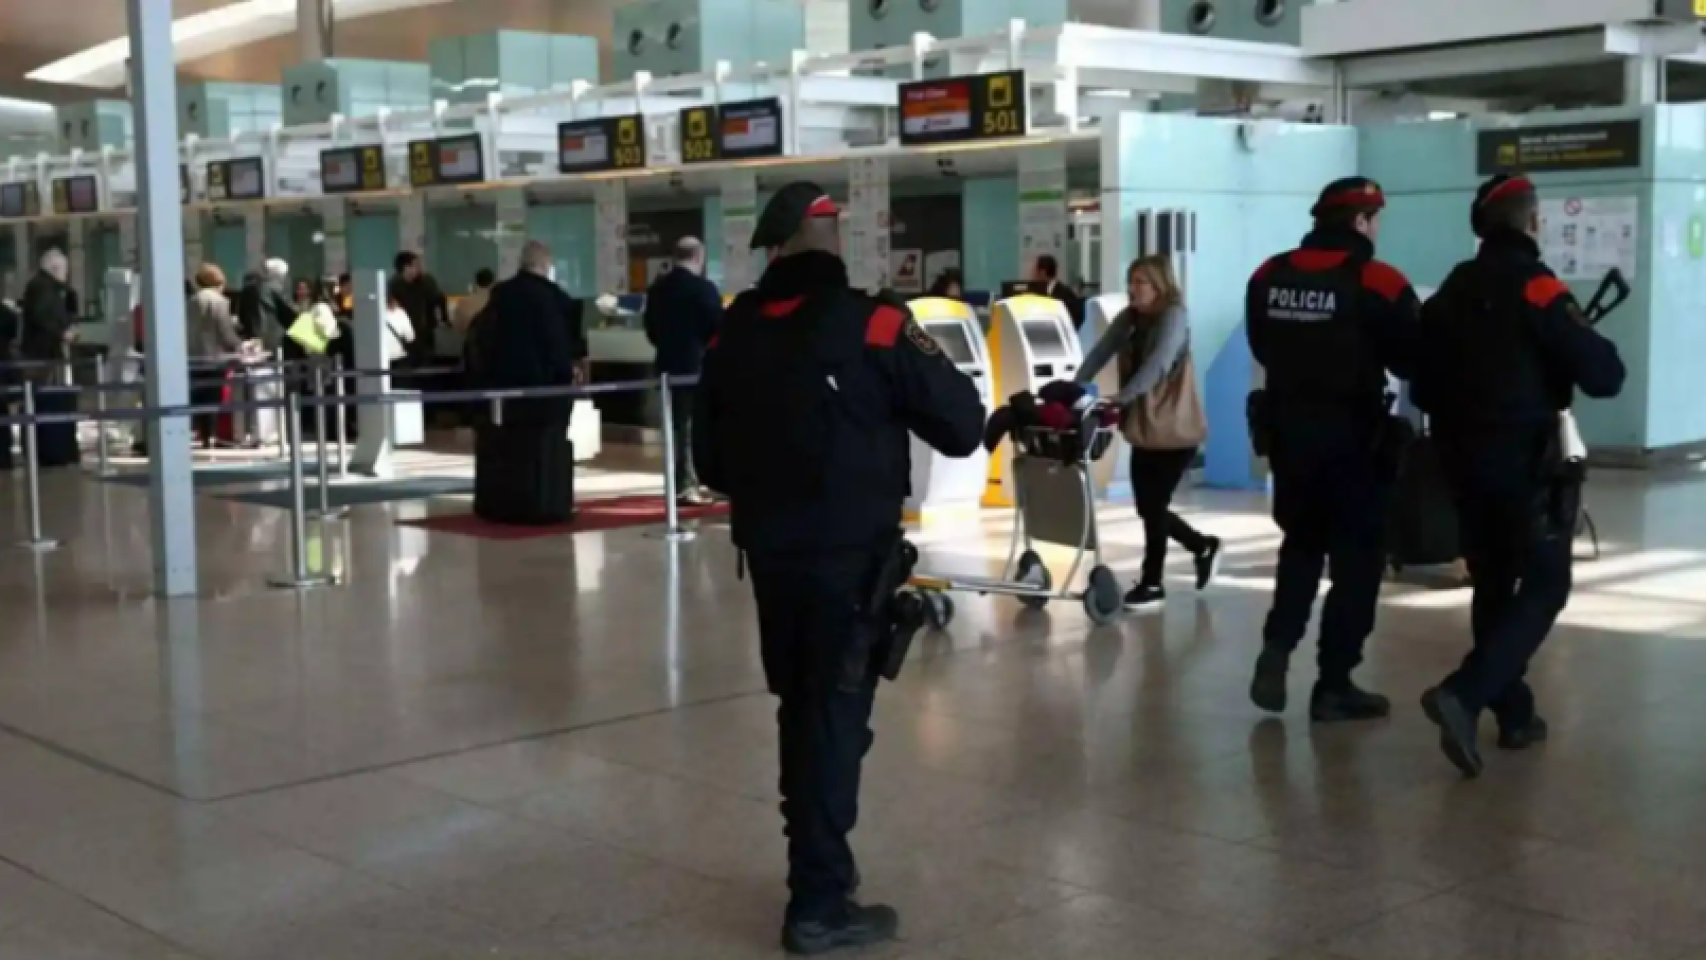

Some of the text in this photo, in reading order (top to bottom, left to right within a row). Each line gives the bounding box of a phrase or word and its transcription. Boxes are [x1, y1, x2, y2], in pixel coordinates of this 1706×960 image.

[983, 109, 1018, 134] 501
[684, 139, 713, 159] 502
[1270, 287, 1336, 311] POLICIA
